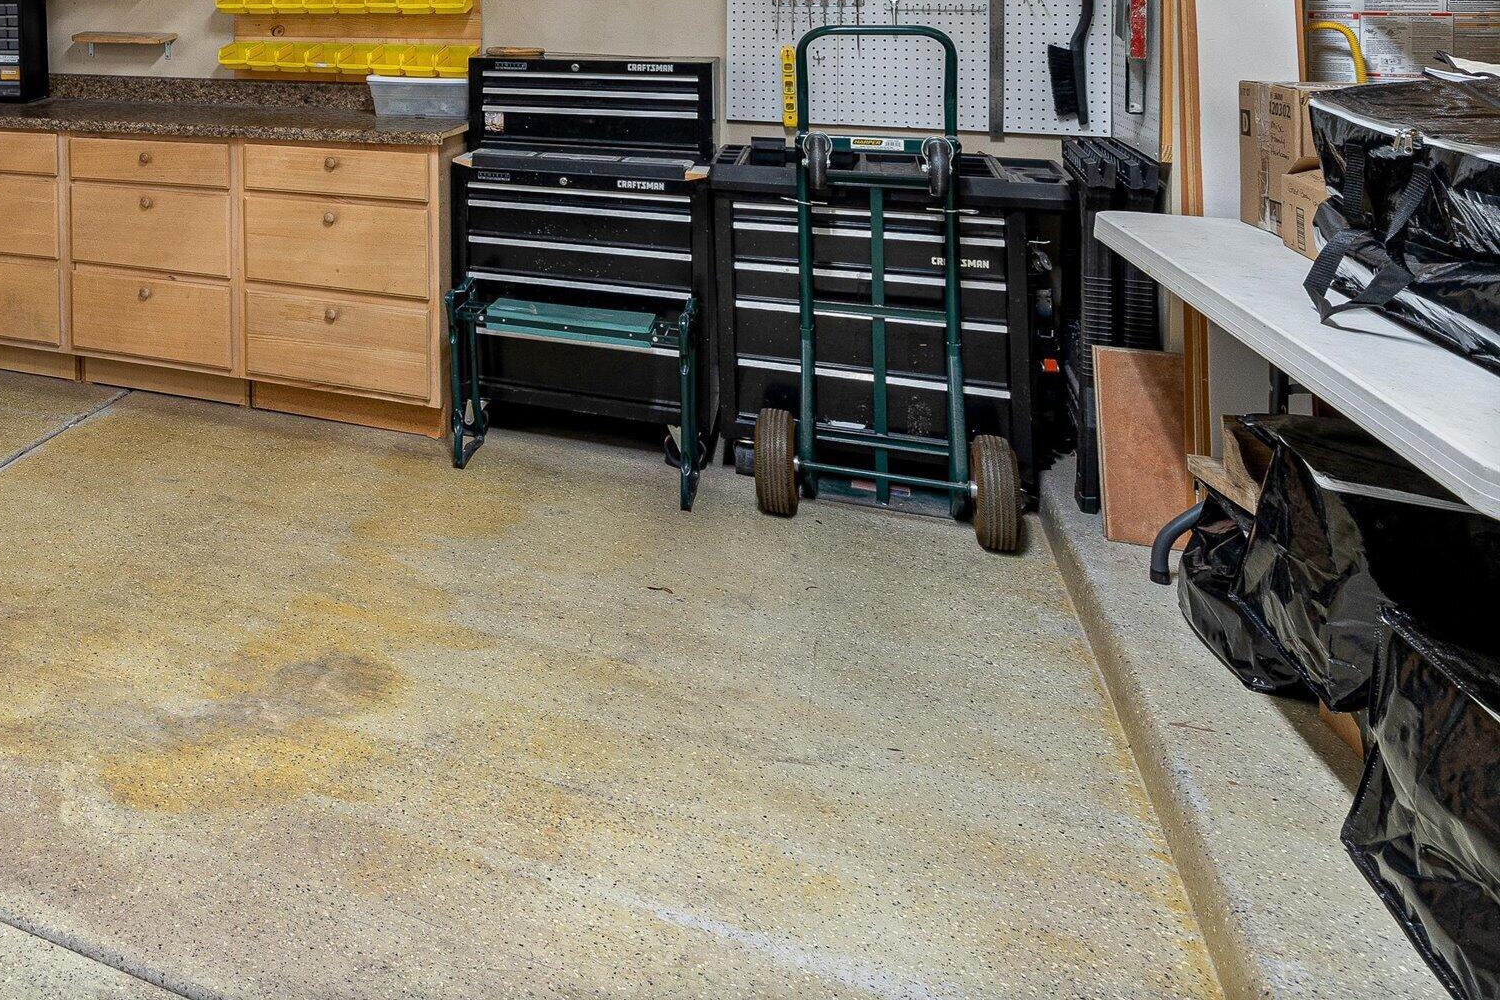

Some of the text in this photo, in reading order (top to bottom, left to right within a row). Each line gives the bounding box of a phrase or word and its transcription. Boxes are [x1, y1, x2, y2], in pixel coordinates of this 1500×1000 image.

[627, 63, 674, 72] CRAFTSMAN
[1269, 101, 1291, 118] 120302
[617, 180, 665, 191] CRAFTSMAN
[931, 257, 990, 269] CRSMAN
